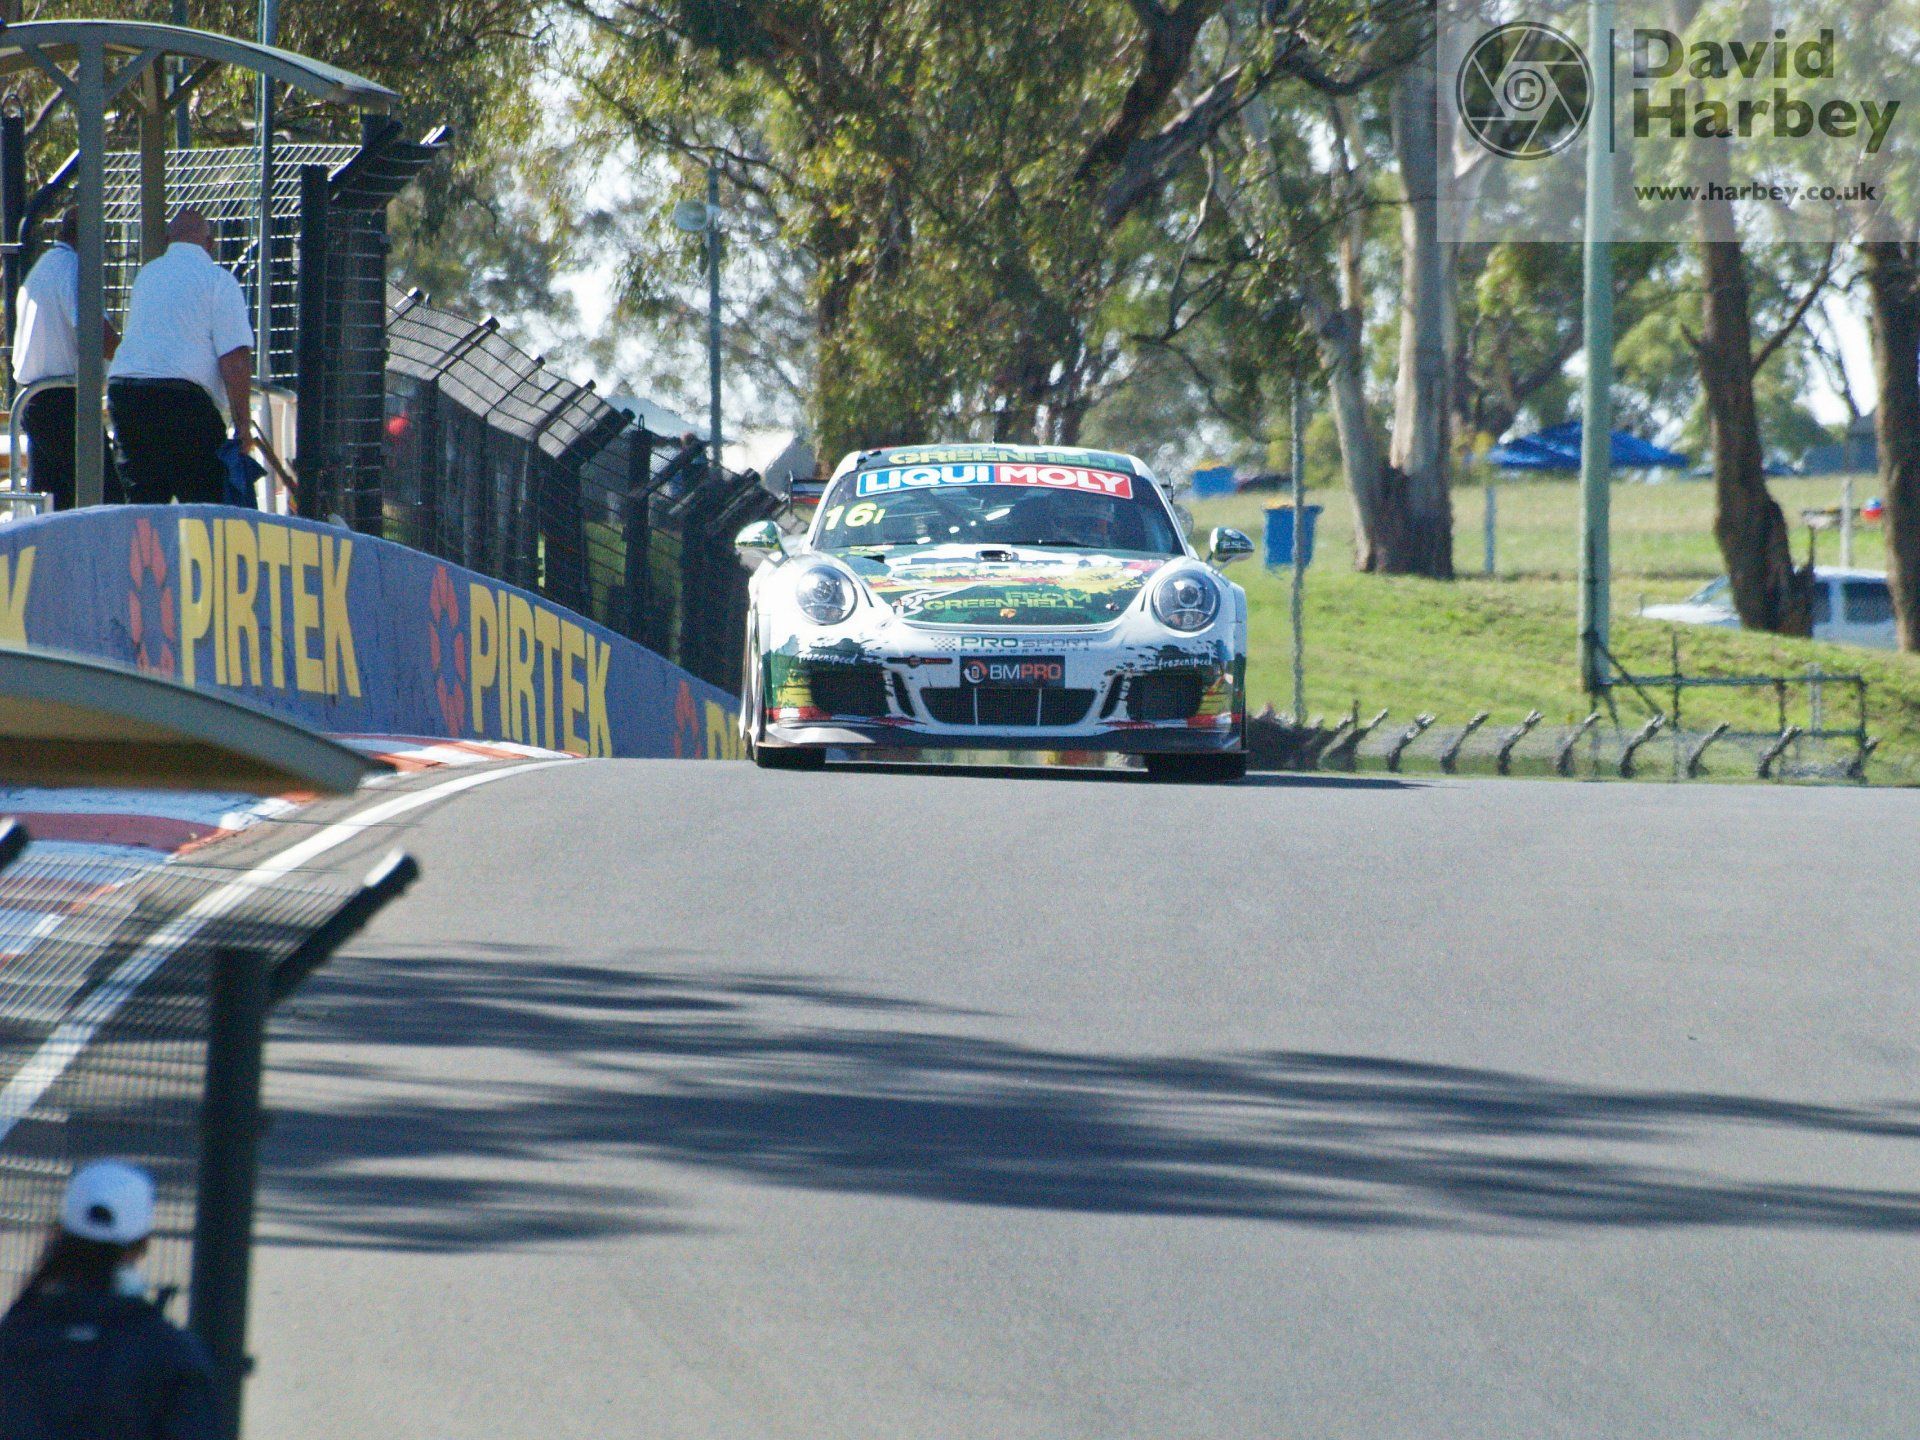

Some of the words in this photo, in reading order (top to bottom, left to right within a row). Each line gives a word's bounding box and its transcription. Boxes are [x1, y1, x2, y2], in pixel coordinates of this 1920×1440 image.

[865, 465, 990, 492] LIQUI
[999, 465, 1126, 493] MOLY
[178, 518, 361, 698] PIRTEK
[961, 637, 1018, 647] PRO
[1022, 637, 1093, 647] SPORT
[469, 582, 612, 758] PIRTEK
[989, 663, 1062, 681] BMPRO
